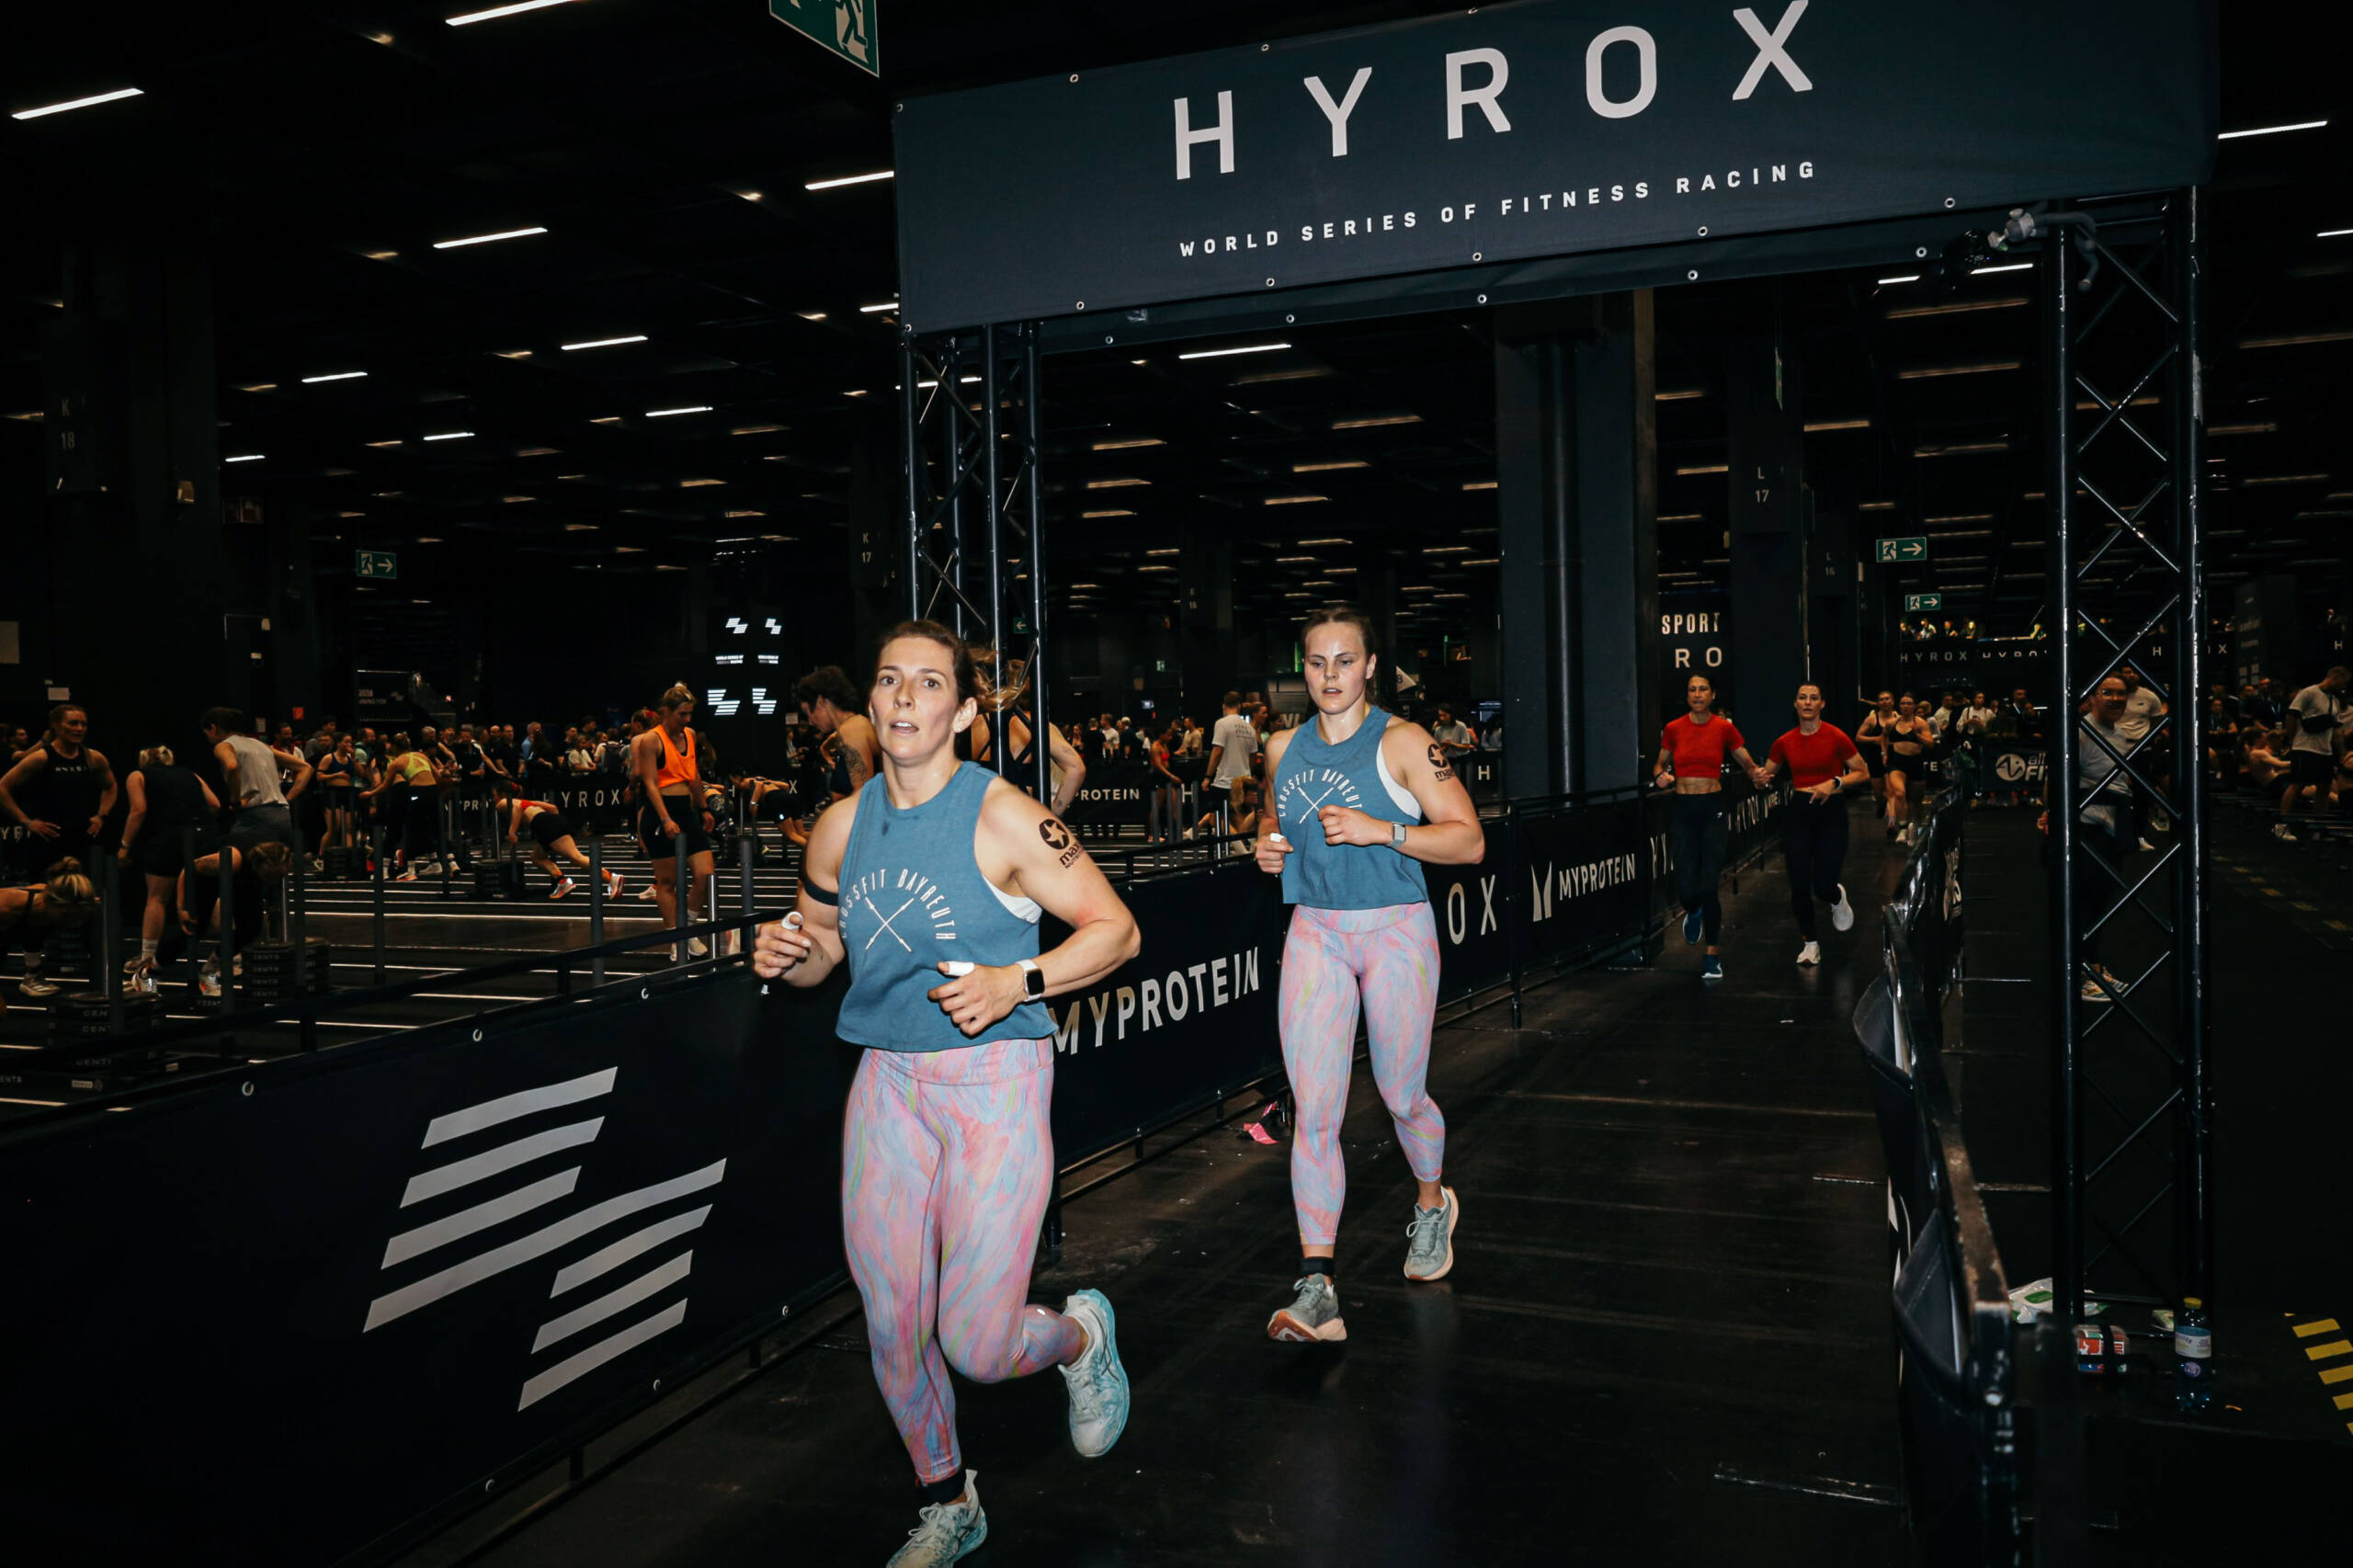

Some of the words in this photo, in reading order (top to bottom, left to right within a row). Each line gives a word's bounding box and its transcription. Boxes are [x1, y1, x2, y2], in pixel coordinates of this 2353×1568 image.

[1174, 0, 1813, 180] HYROX
[1179, 230, 1279, 257] WORLD
[1301, 211, 1416, 242] SERIES
[1440, 203, 1476, 223] OF
[1501, 182, 1649, 216] FITNESS
[1676, 161, 1814, 194] RACING
[60, 430, 75, 449] 18
[1756, 465, 1766, 480] L
[1755, 489, 1770, 504] 17
[1660, 611, 1722, 635] SPORT
[1900, 650, 1969, 663] HYROX
[1321, 768, 1363, 809] BAYREUT
[1559, 853, 1636, 902] MYPROTEIN
[897, 868, 957, 939] BAYREUTH
[1049, 946, 1260, 1056] MYPROTEIN
